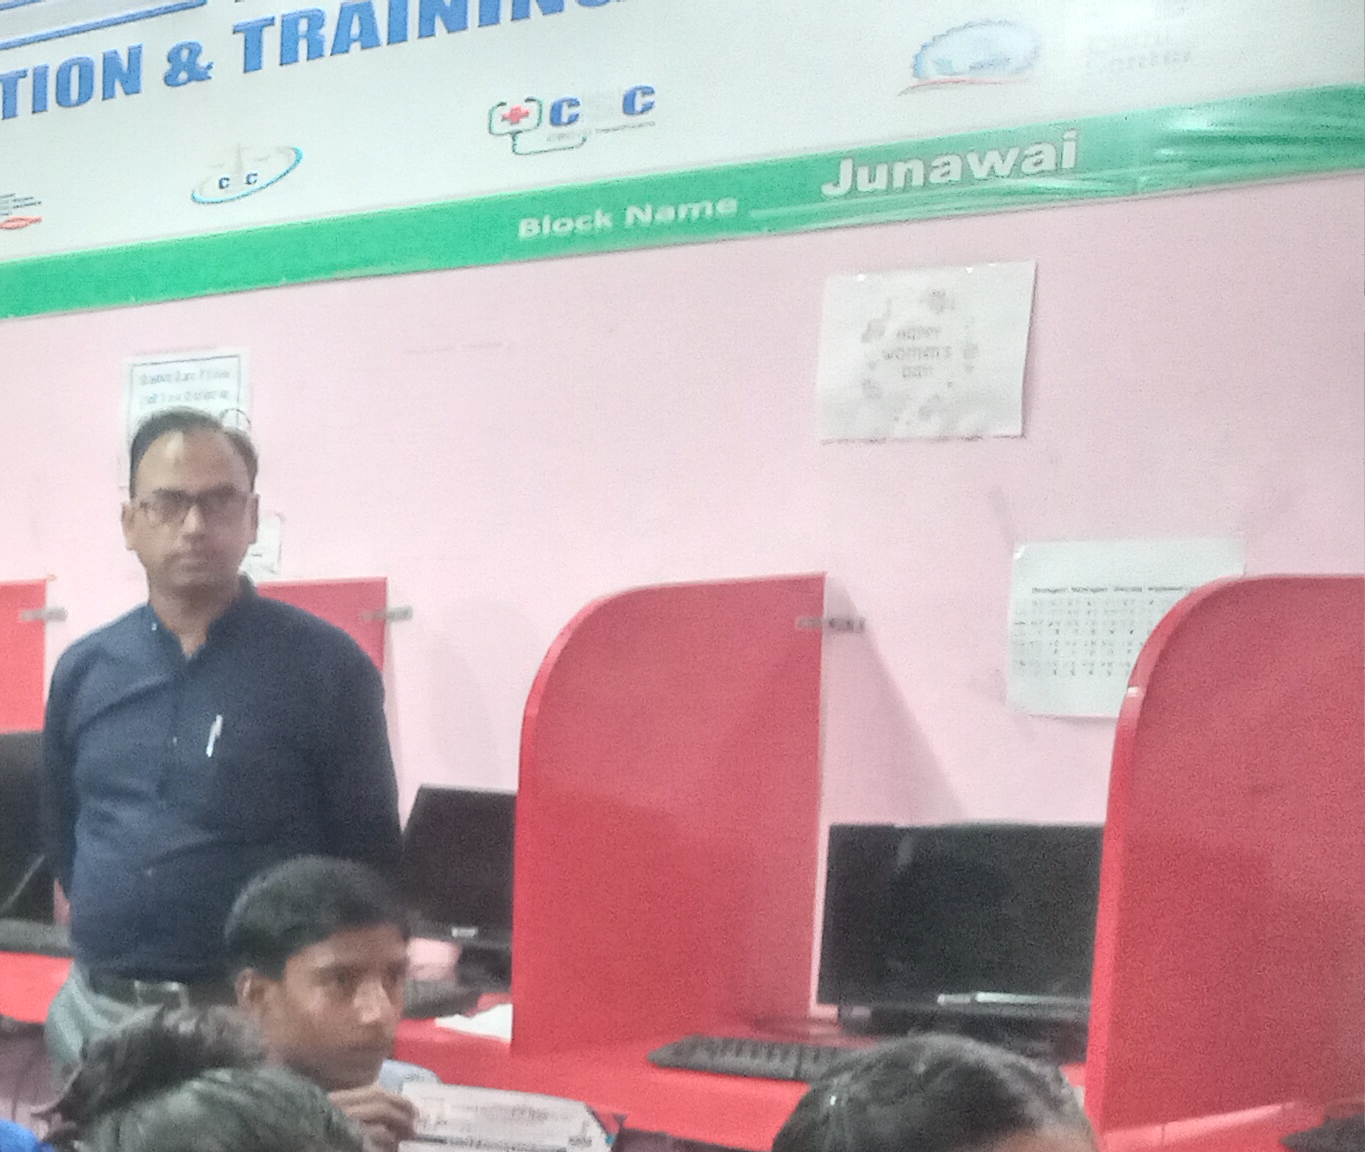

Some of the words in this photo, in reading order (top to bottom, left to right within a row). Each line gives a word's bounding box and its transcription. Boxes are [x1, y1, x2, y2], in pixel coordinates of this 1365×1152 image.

[164, 40, 213, 87] &
[820, 128, 1079, 198] Junawai
[518, 208, 613, 240] Block
[625, 196, 738, 227] Name
